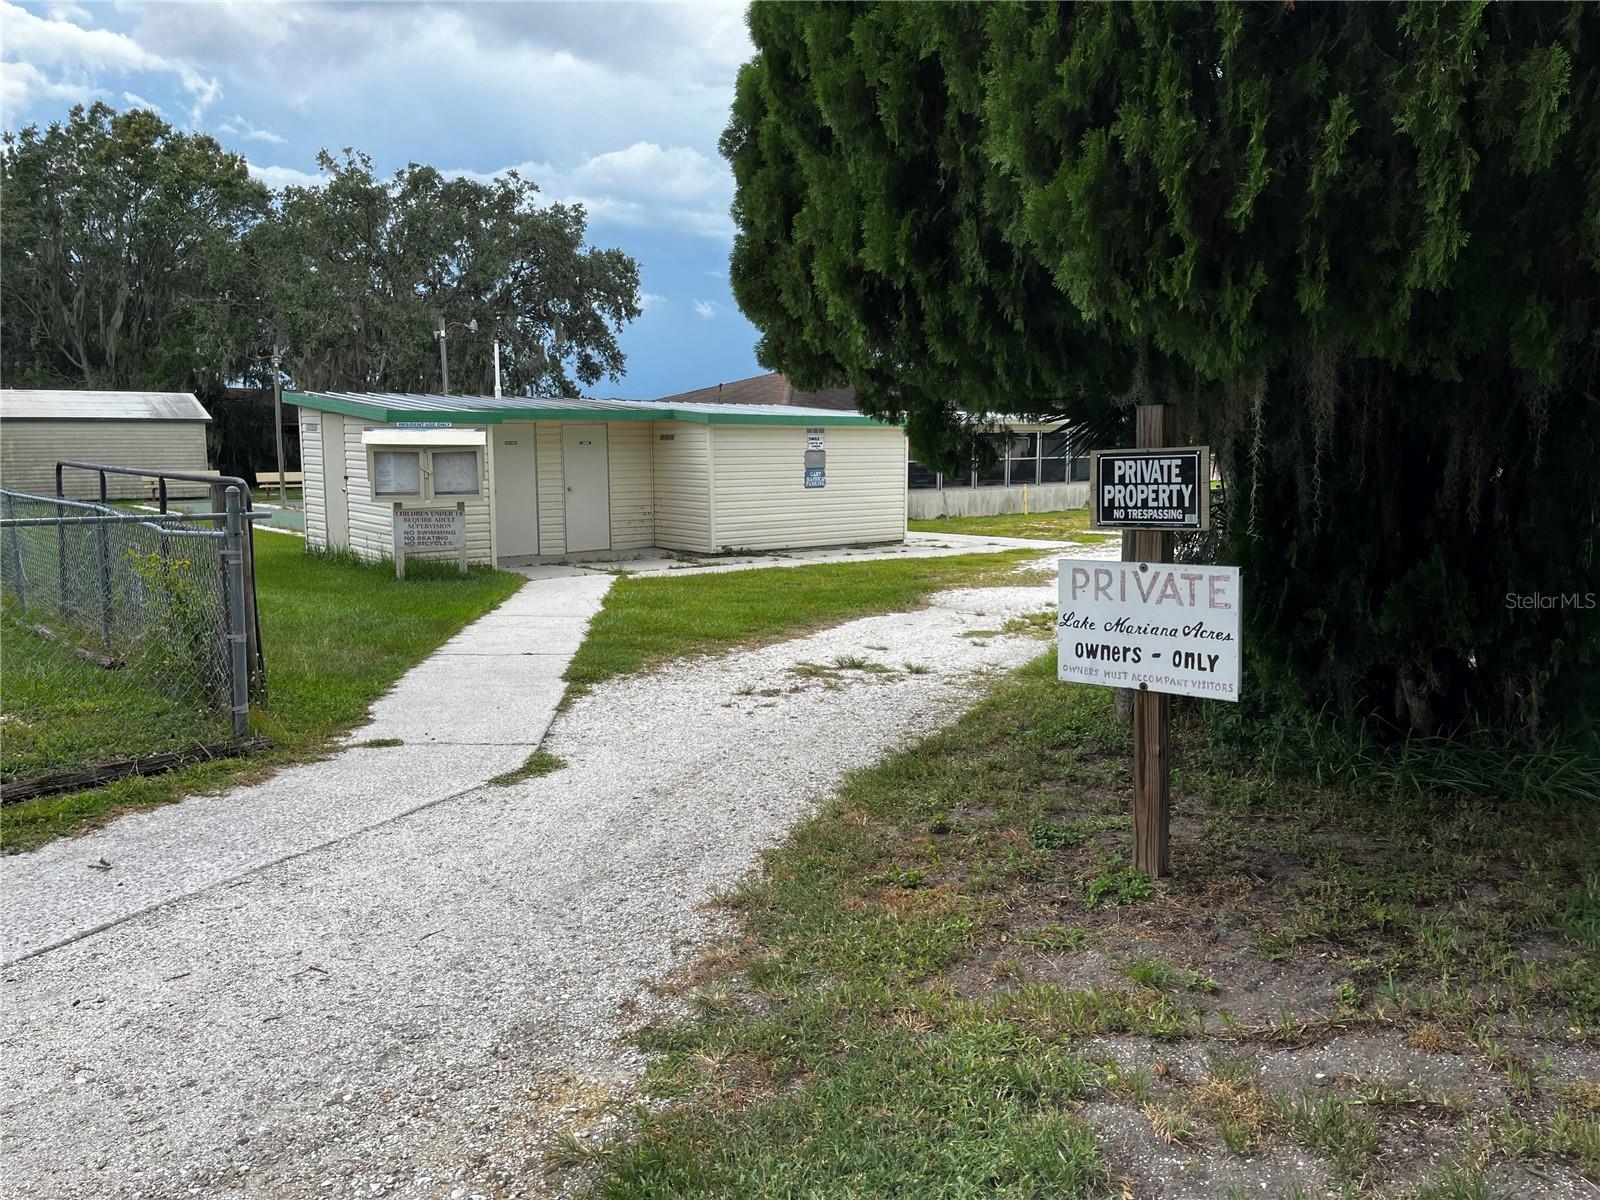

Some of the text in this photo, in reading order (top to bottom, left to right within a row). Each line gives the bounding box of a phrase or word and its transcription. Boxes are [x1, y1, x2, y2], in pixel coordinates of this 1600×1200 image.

[1114, 459, 1182, 483] PRIVATE
[1103, 484, 1193, 507] PROPERTY
[1113, 509, 1125, 519] NO
[1128, 509, 1183, 519] TRESPASSING
[1071, 567, 1232, 610] PRIVATE
[1059, 611, 1234, 642] Lake Mariana Acres
[1062, 664, 1234, 693] OWNERS MUST ACCOMPANY VISITORS
